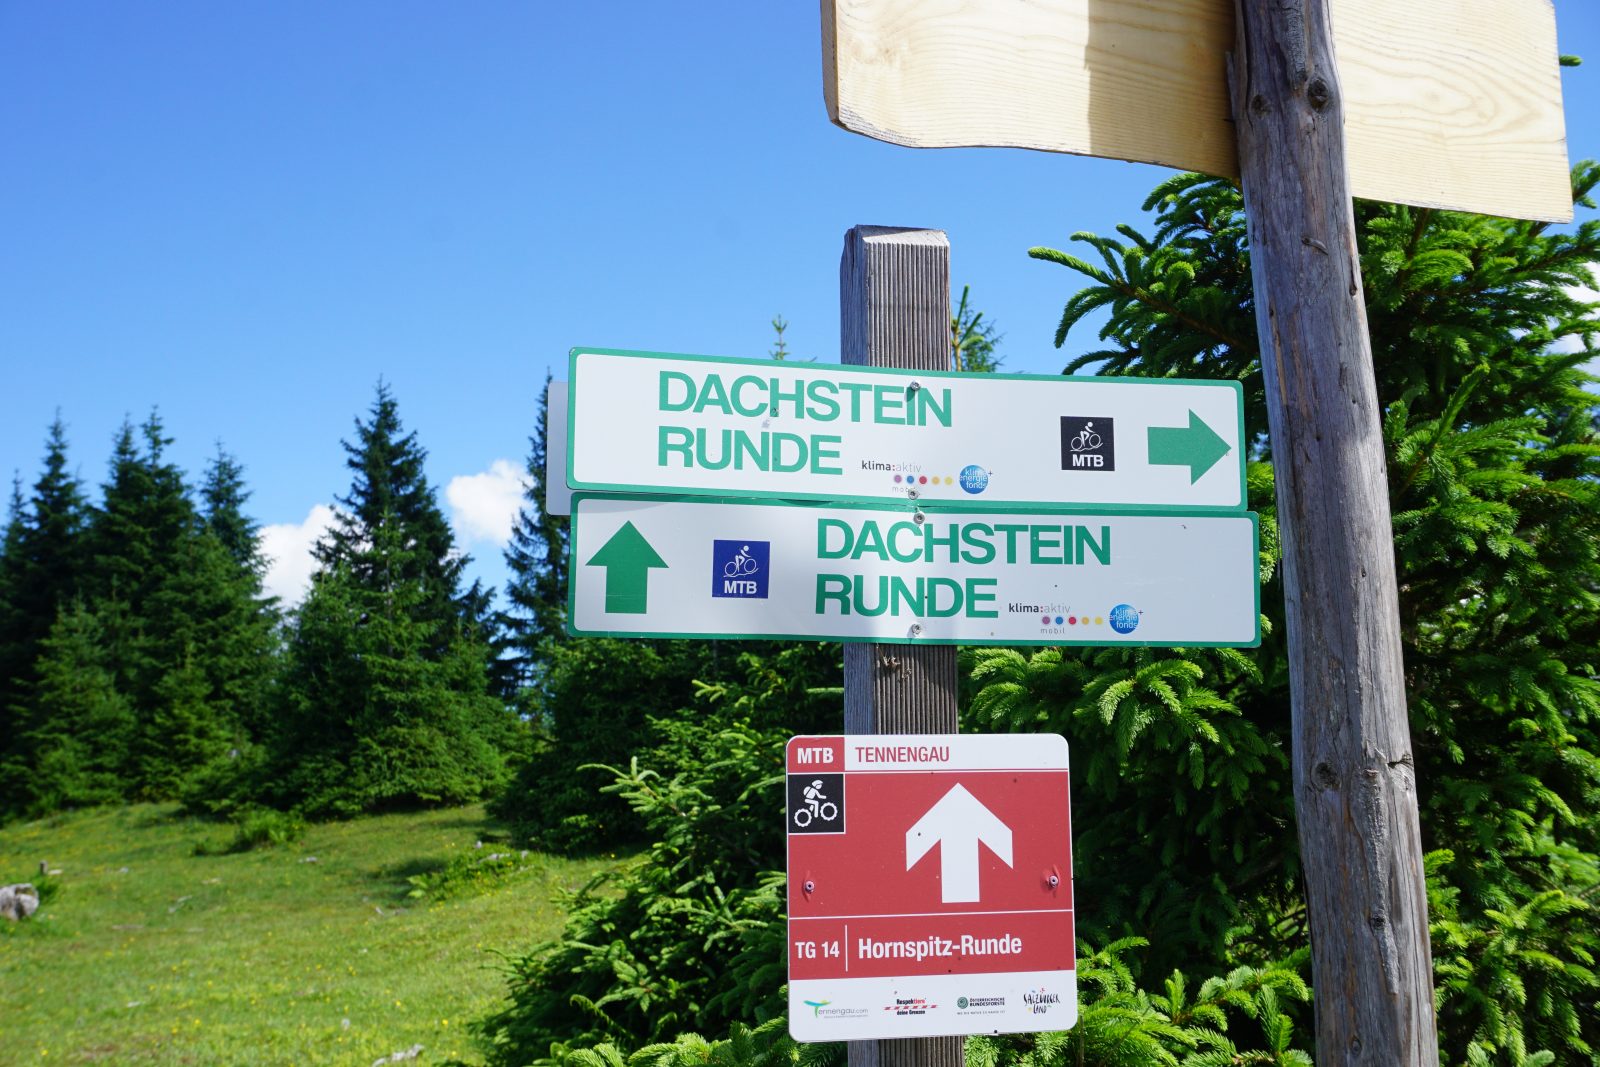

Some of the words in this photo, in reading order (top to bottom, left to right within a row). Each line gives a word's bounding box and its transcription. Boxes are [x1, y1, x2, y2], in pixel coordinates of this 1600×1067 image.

[658, 370, 952, 427] DACHSTEIN
[657, 425, 843, 476] RUNDE
[861, 460, 922, 473] klima:aktiv
[1072, 453, 1105, 468] MTB
[816, 518, 1111, 566] DACHSTEIN
[723, 580, 758, 595] MTB
[815, 573, 999, 618] RUNDE
[1008, 603, 1071, 614] klima:aktiv
[797, 747, 834, 764] MTB
[855, 746, 950, 763] TENNENGAU
[795, 942, 817, 959] TG
[822, 941, 840, 958] 14
[858, 933, 1022, 961] Hornspitz-Runde
